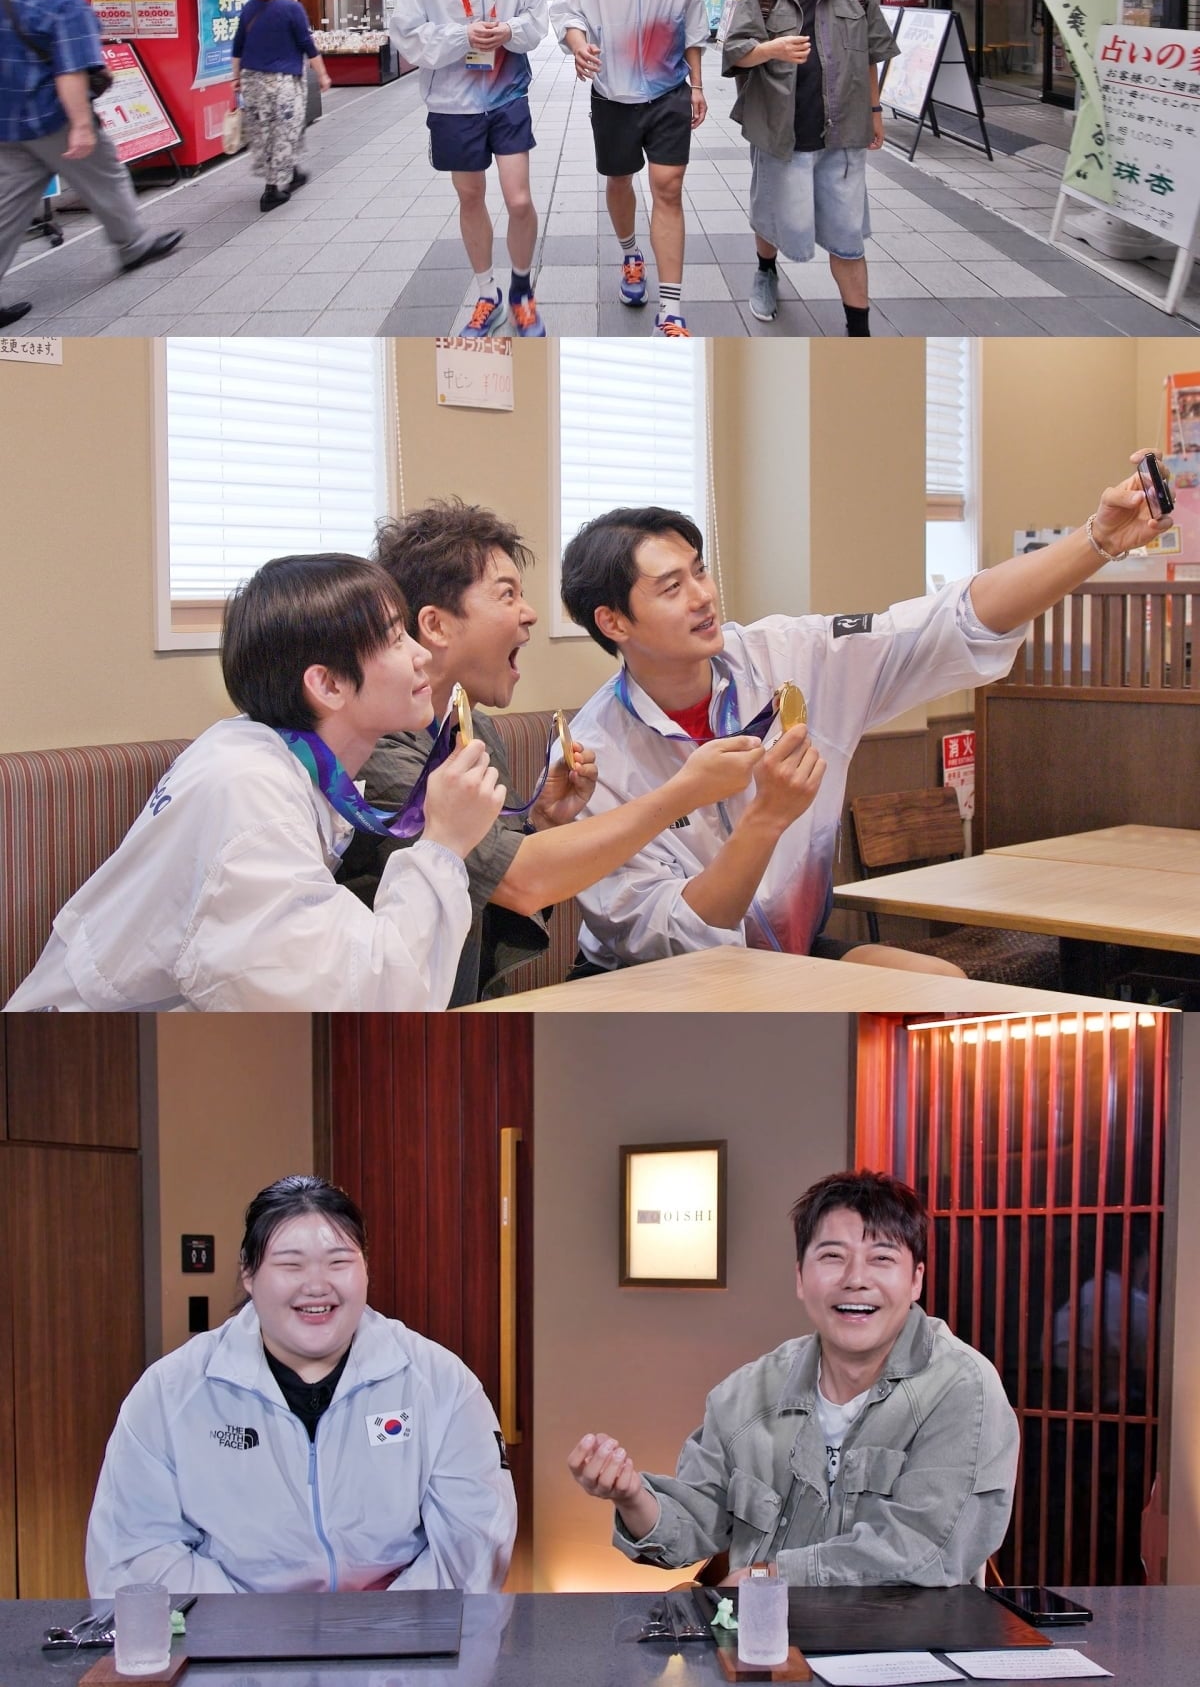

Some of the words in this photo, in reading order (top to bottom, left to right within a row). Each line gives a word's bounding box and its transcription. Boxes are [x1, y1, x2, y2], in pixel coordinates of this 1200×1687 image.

[138, 9, 169, 18] 20,000
[102, 49, 116, 60] 16
[0, 338, 54, 356] 変更できます。
[949, 736, 973, 758] 消火
[663, 1209, 712, 1222] OISHI
[209, 1429, 243, 1442] NORTH
[225, 1424, 244, 1435] THE
[219, 1439, 243, 1450] FACE
